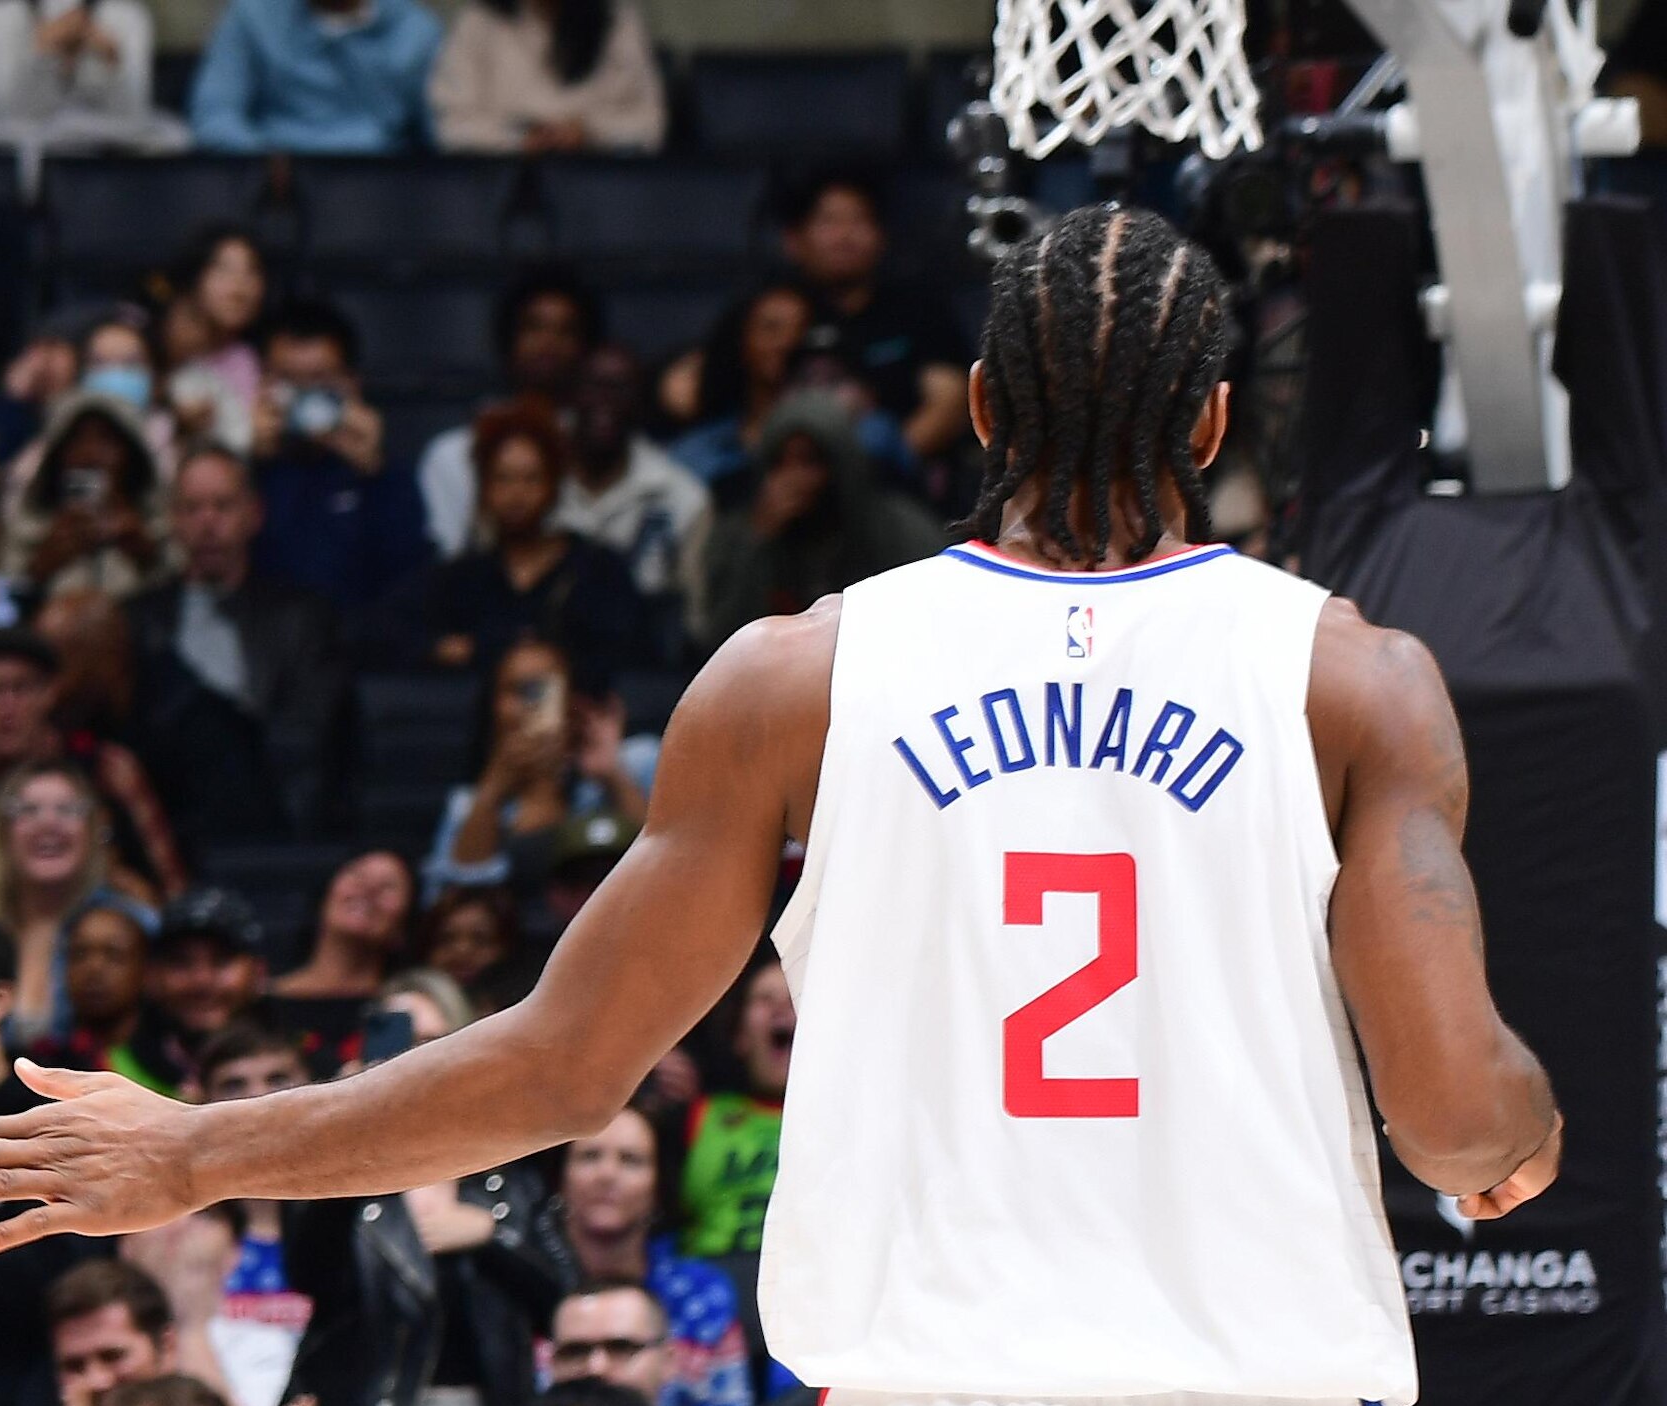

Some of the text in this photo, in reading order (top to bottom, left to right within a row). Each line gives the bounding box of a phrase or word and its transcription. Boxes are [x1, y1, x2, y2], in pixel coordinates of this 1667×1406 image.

[892, 681, 1244, 812] LEONARD
[1002, 852, 1138, 1118] 2
[1402, 1249, 1598, 1289] CHANGA
